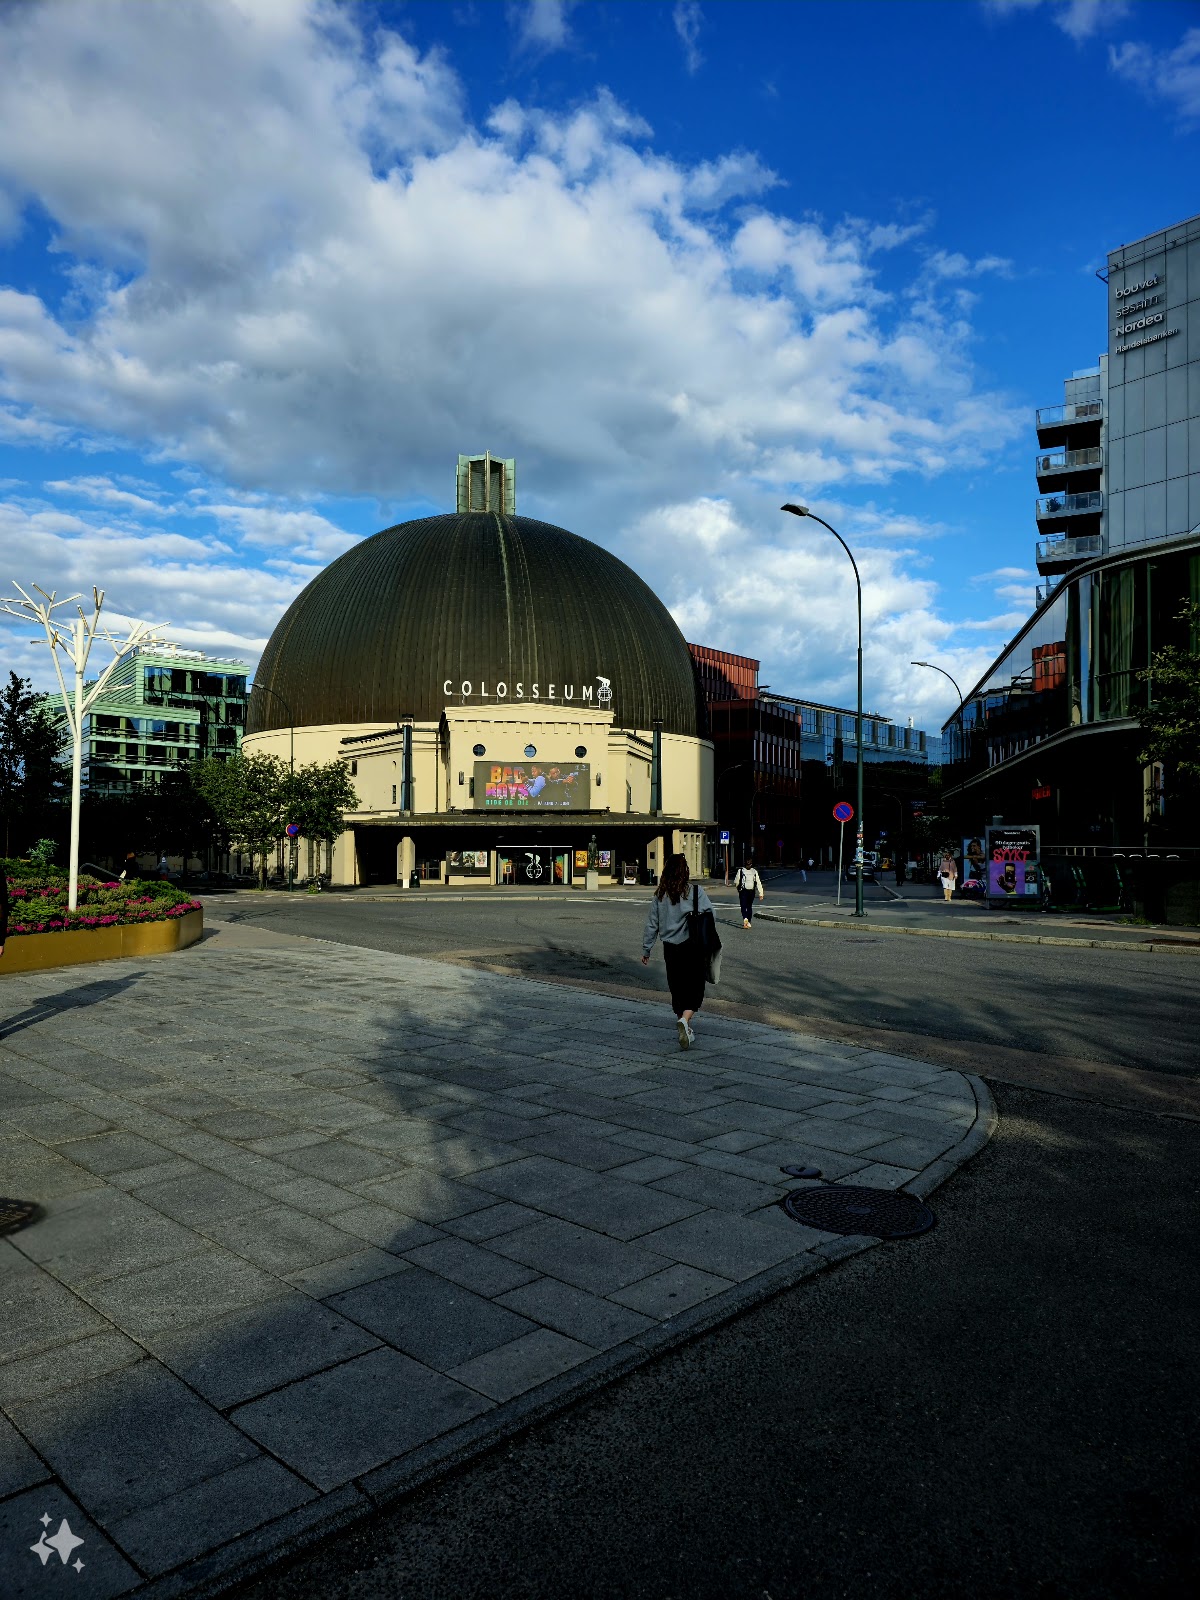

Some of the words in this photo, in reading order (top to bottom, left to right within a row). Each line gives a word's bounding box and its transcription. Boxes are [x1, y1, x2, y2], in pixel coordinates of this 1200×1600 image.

[1115, 274, 1159, 299] bouvet
[1115, 313, 1163, 337] Nordea
[1115, 328, 1178, 354] Handelsbanken
[443, 679, 593, 700] COLOSSEUM
[490, 765, 525, 784] BAD
[485, 783, 529, 800] BOYS
